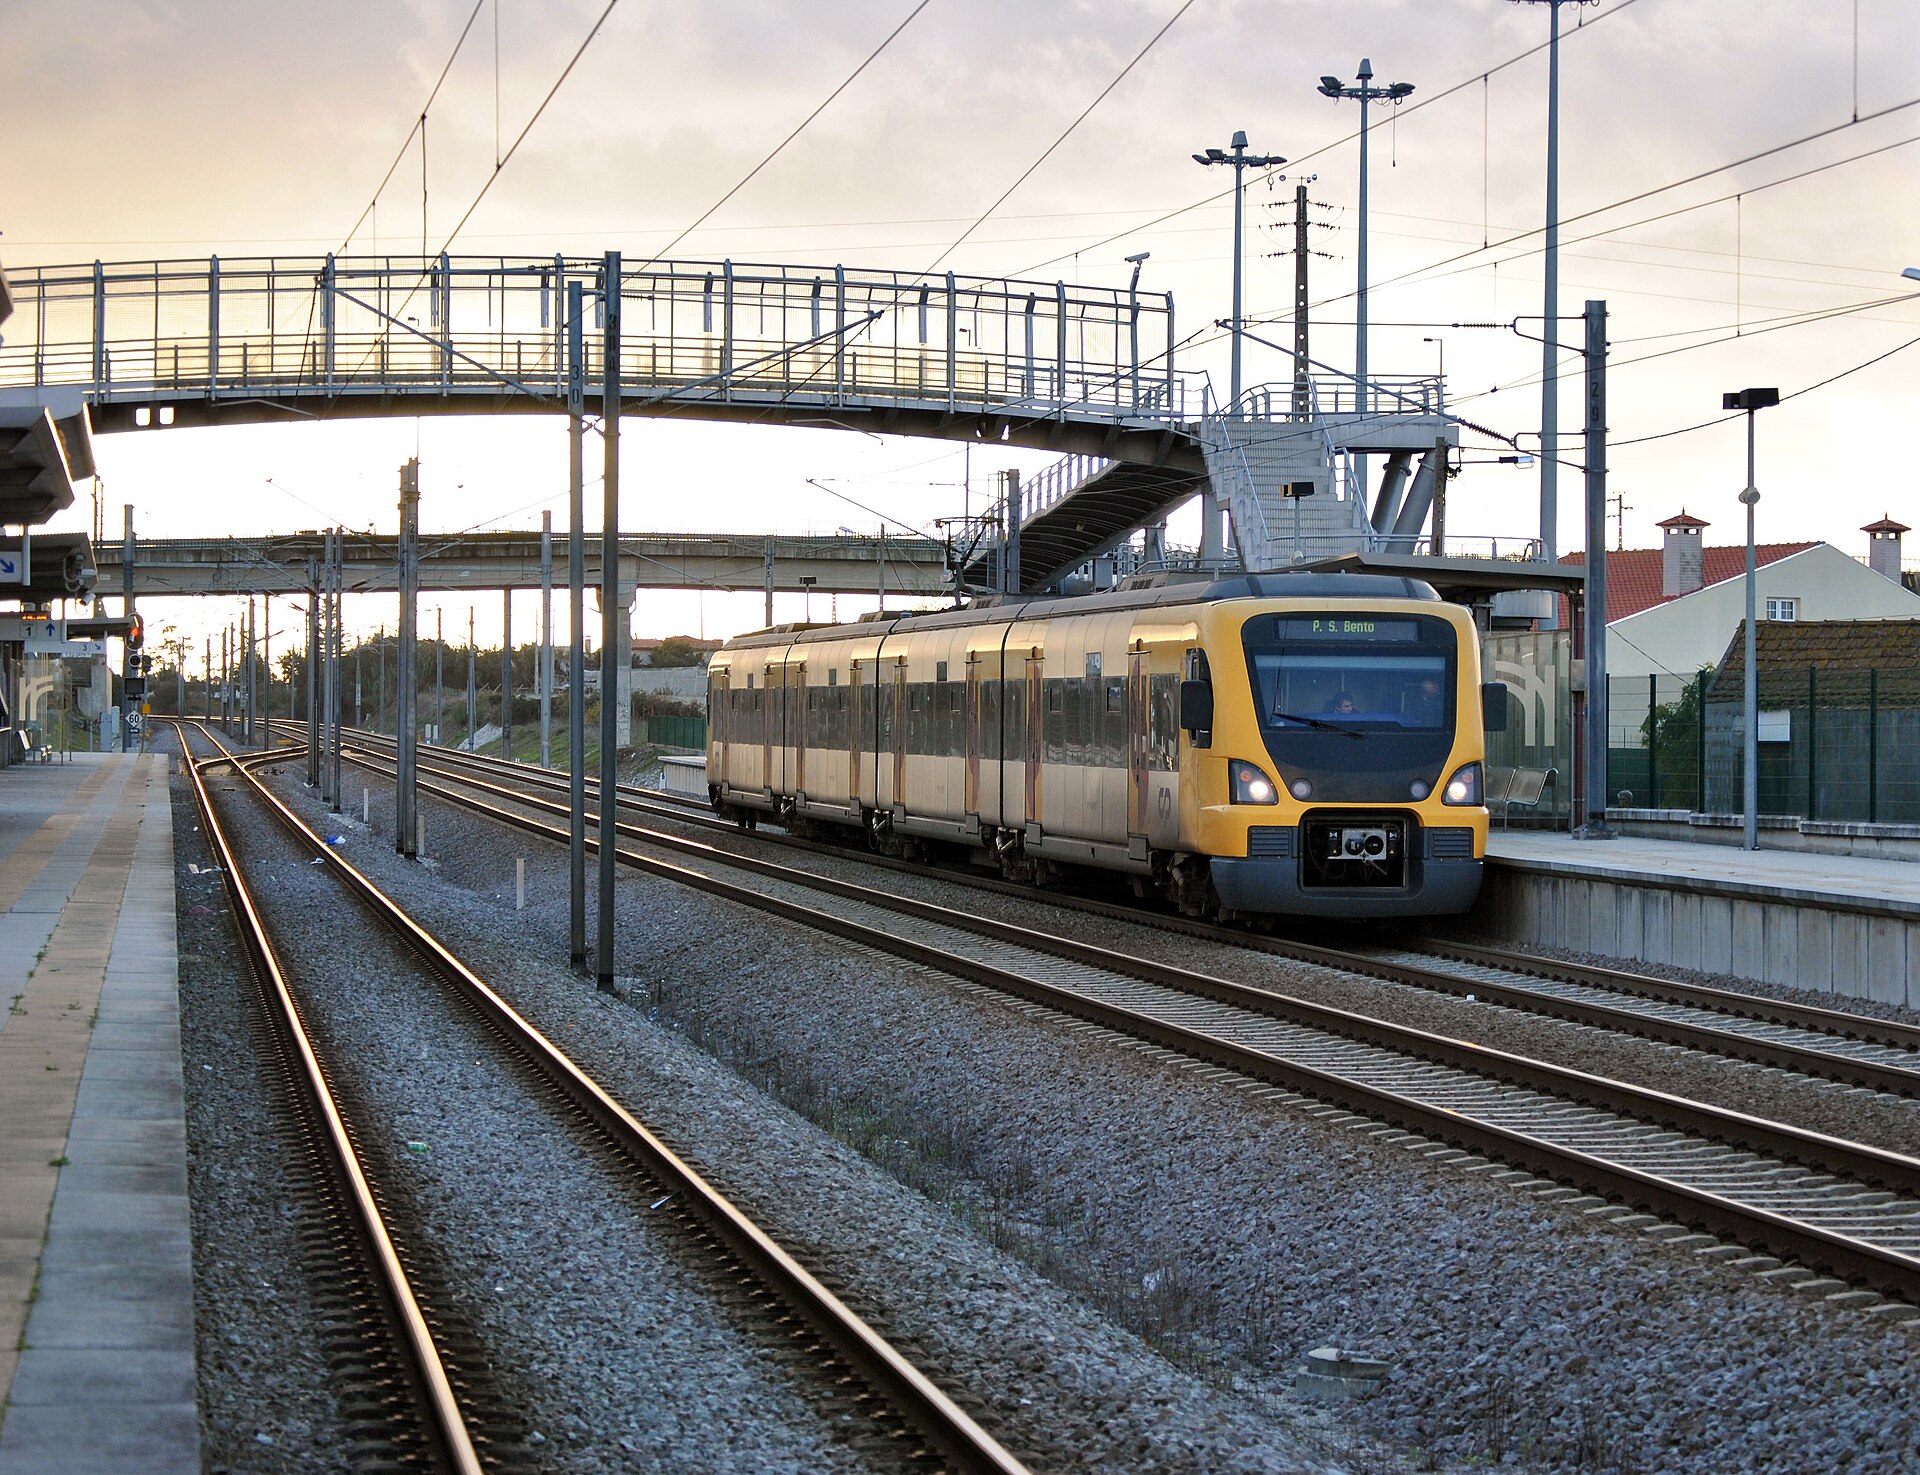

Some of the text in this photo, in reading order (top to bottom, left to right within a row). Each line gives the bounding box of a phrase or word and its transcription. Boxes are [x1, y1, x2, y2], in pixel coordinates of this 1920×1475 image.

[572, 364, 580, 405] 30
[1591, 382, 1599, 422] 29
[1011, 515, 1017, 539] 27
[25, 627, 31, 637] 1
[1313, 620, 1375, 633] P. S. Bento
[129, 714, 140, 724] 60
